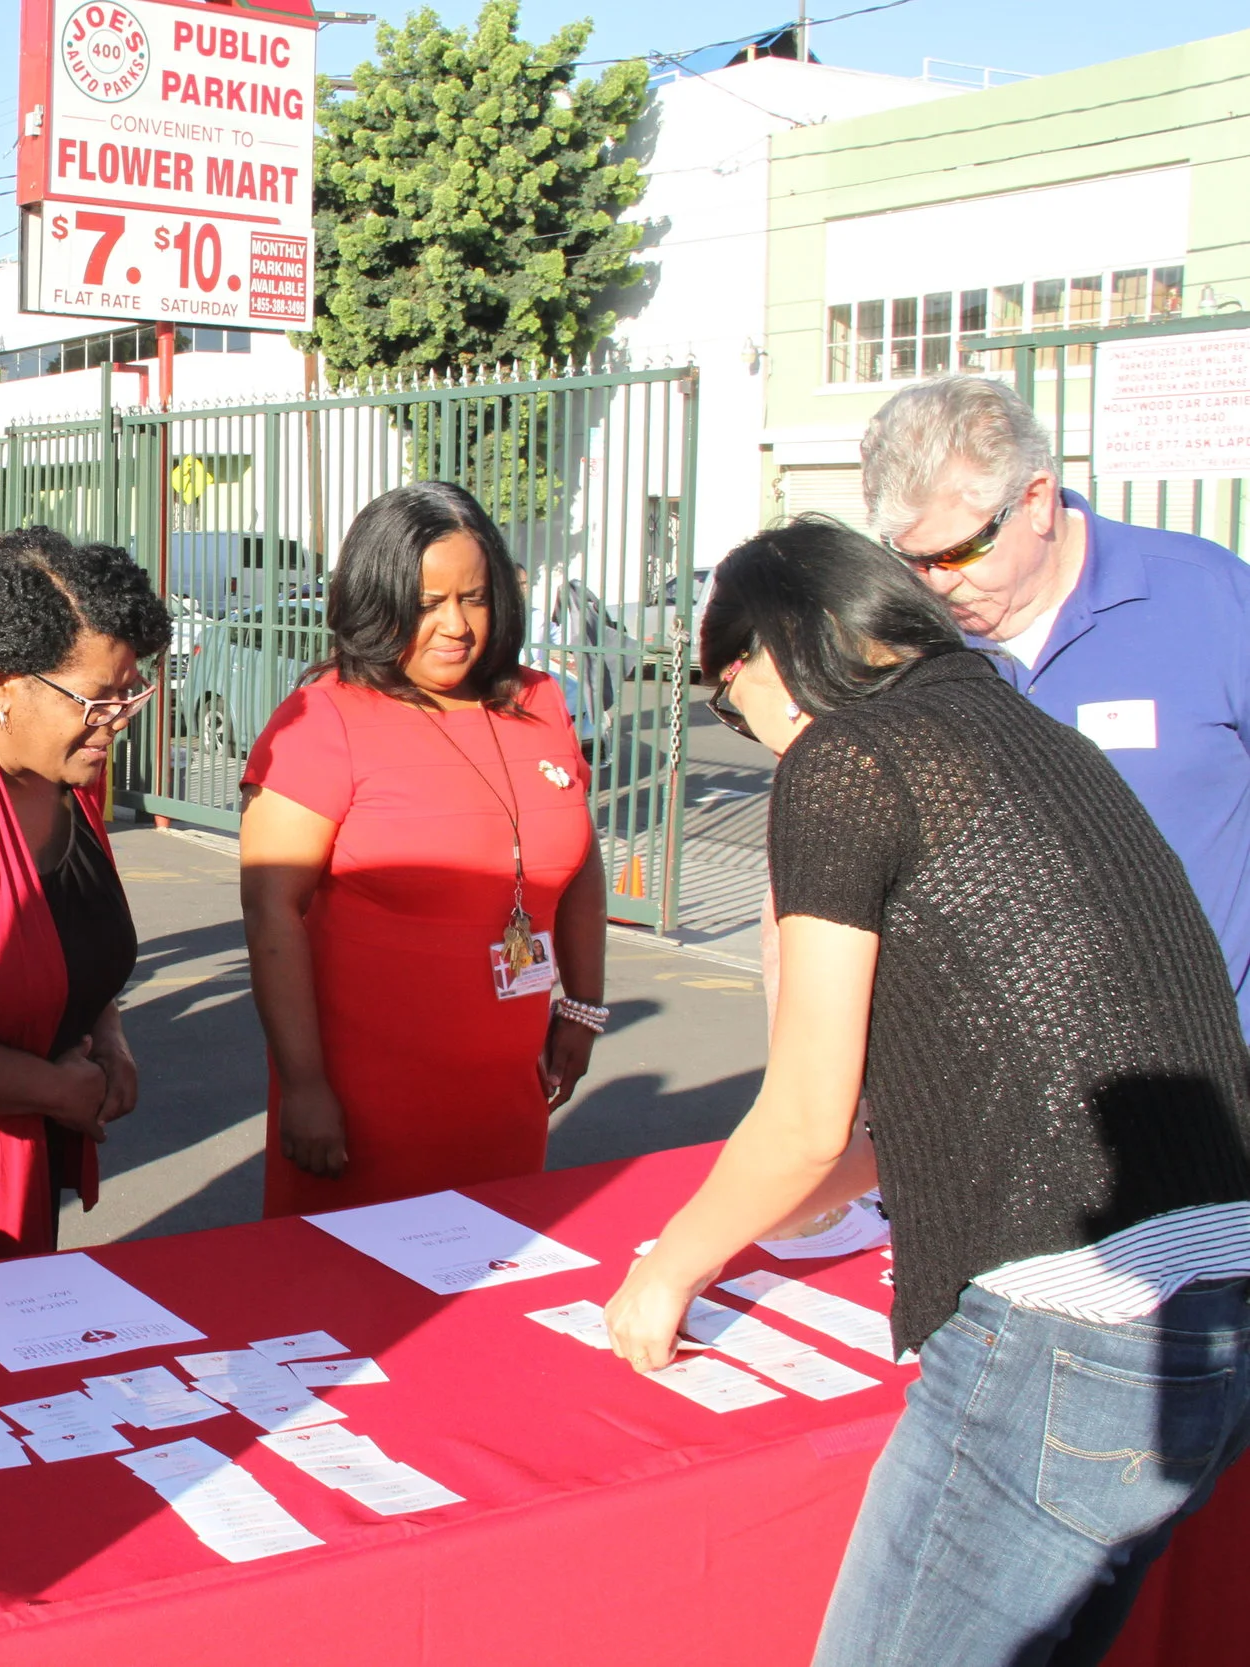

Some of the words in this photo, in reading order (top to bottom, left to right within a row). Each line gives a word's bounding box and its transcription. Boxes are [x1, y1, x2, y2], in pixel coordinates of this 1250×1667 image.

[72, 6, 144, 53] JOE'S
[92, 43, 121, 60] 400
[174, 20, 290, 68] PUBLIC
[67, 50, 98, 93] AUTO
[104, 58, 145, 97] PARKS
[161, 69, 304, 120] PARKING
[110, 114, 223, 143] CONVENIENT
[231, 130, 254, 148] TO
[58, 138, 194, 193] FLOWER
[206, 156, 299, 205] MART
[252, 240, 306, 259] MONTHLY
[252, 259, 304, 278] PARKING
[251, 278, 305, 297] AVAILABLE
[54, 289, 98, 306] FLAT
[101, 292, 141, 311] RATE
[161, 298, 239, 318] SATURDAY
[1158, 356, 1201, 369] VEHICLES
[1206, 355, 1226, 365] WILL
[1231, 353, 1243, 363] BE
[1182, 381, 1200, 392] AND
[1204, 377, 1247, 389] EXPENSE
[1103, 400, 1173, 413] HOLLYWOOD
[1177, 398, 1201, 410] CAR
[1137, 416, 1159, 427] 323
[1106, 441, 1151, 452] POLICE
[431, 1266, 492, 1284] CENTERS
[19, 1307, 36, 1315] IN
[38, 1299, 79, 1312] CHECK
[113, 1323, 170, 1339] HEALTH
[12, 1337, 83, 1356] CENTERS
[22, 1345, 89, 1360] CHRISTIAN
